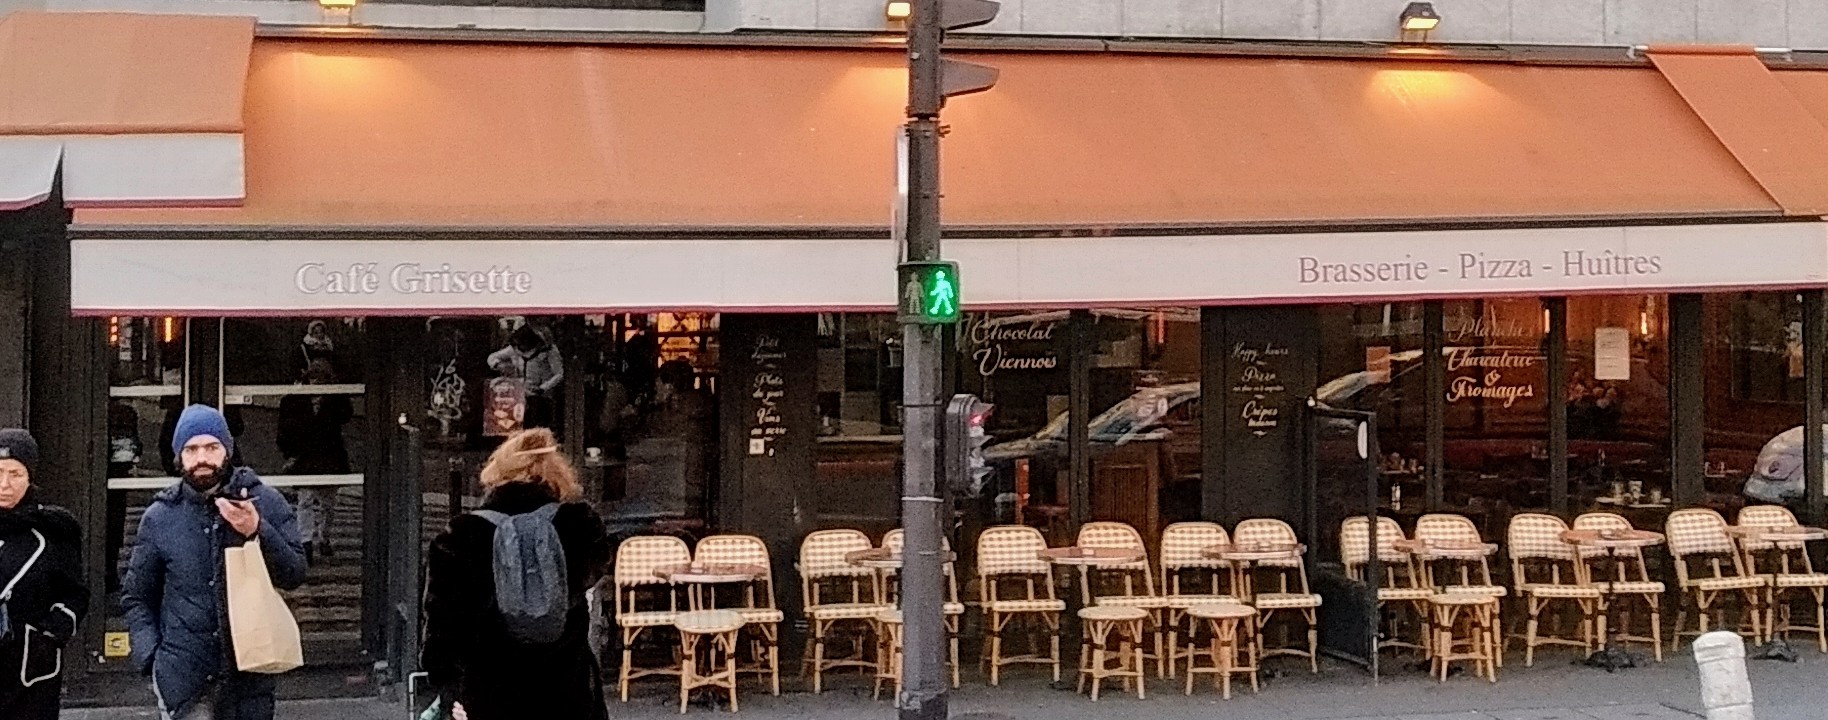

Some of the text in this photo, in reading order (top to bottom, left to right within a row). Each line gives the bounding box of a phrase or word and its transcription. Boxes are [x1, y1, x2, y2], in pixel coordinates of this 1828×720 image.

[294, 262, 533, 295] Café Grisette
[1299, 253, 1428, 284] Brasserie
[1459, 252, 1533, 281] Pizza
[1563, 249, 1663, 278] Huîtres
[971, 318, 1055, 344] Chocolat
[972, 343, 1057, 376] Viennois
[1446, 376, 1533, 408] Fromages
[1484, 369, 1501, 387] &
